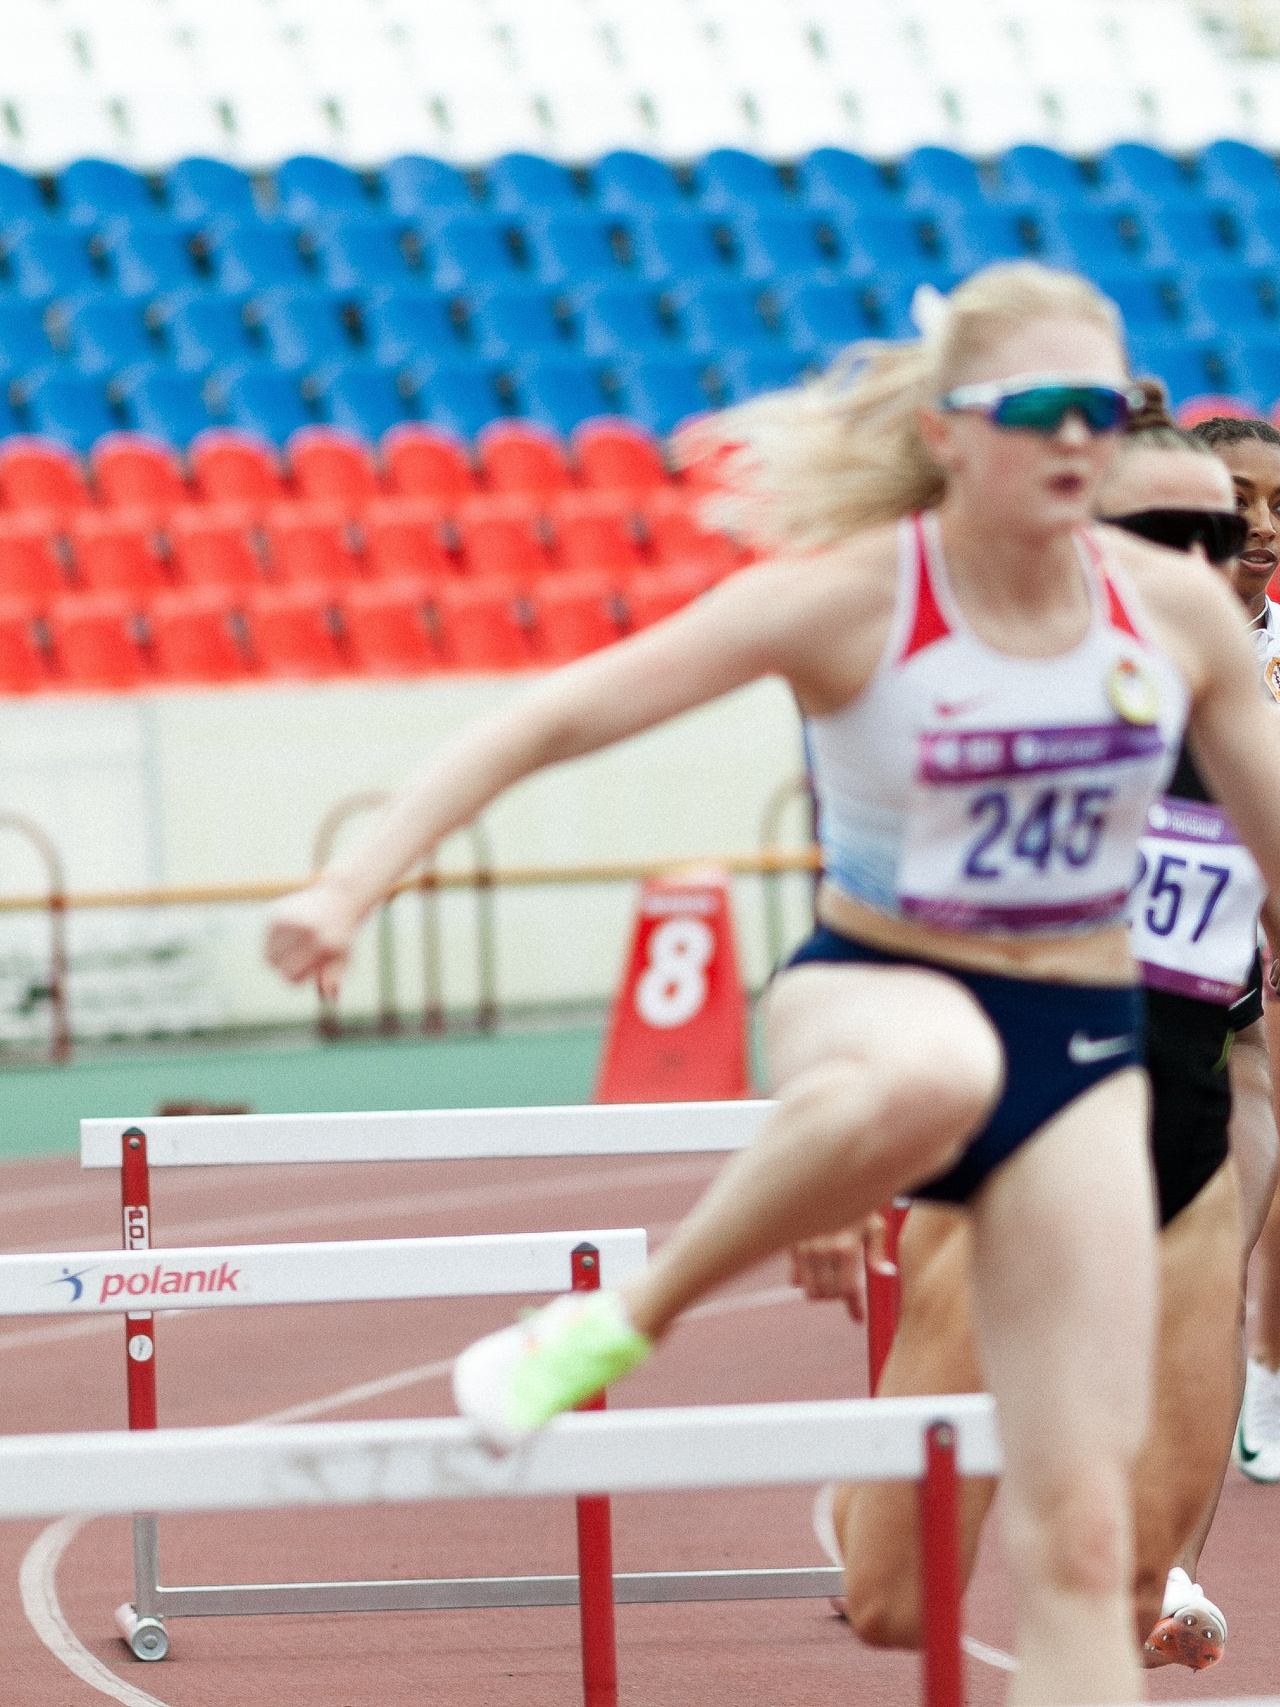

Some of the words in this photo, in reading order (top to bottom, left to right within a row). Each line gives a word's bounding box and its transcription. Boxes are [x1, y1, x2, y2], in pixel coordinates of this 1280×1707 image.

[963, 785, 1115, 879] 245
[1132, 851, 1231, 944] 57
[634, 917, 717, 1029] 8
[99, 1262, 242, 1303] polanik
